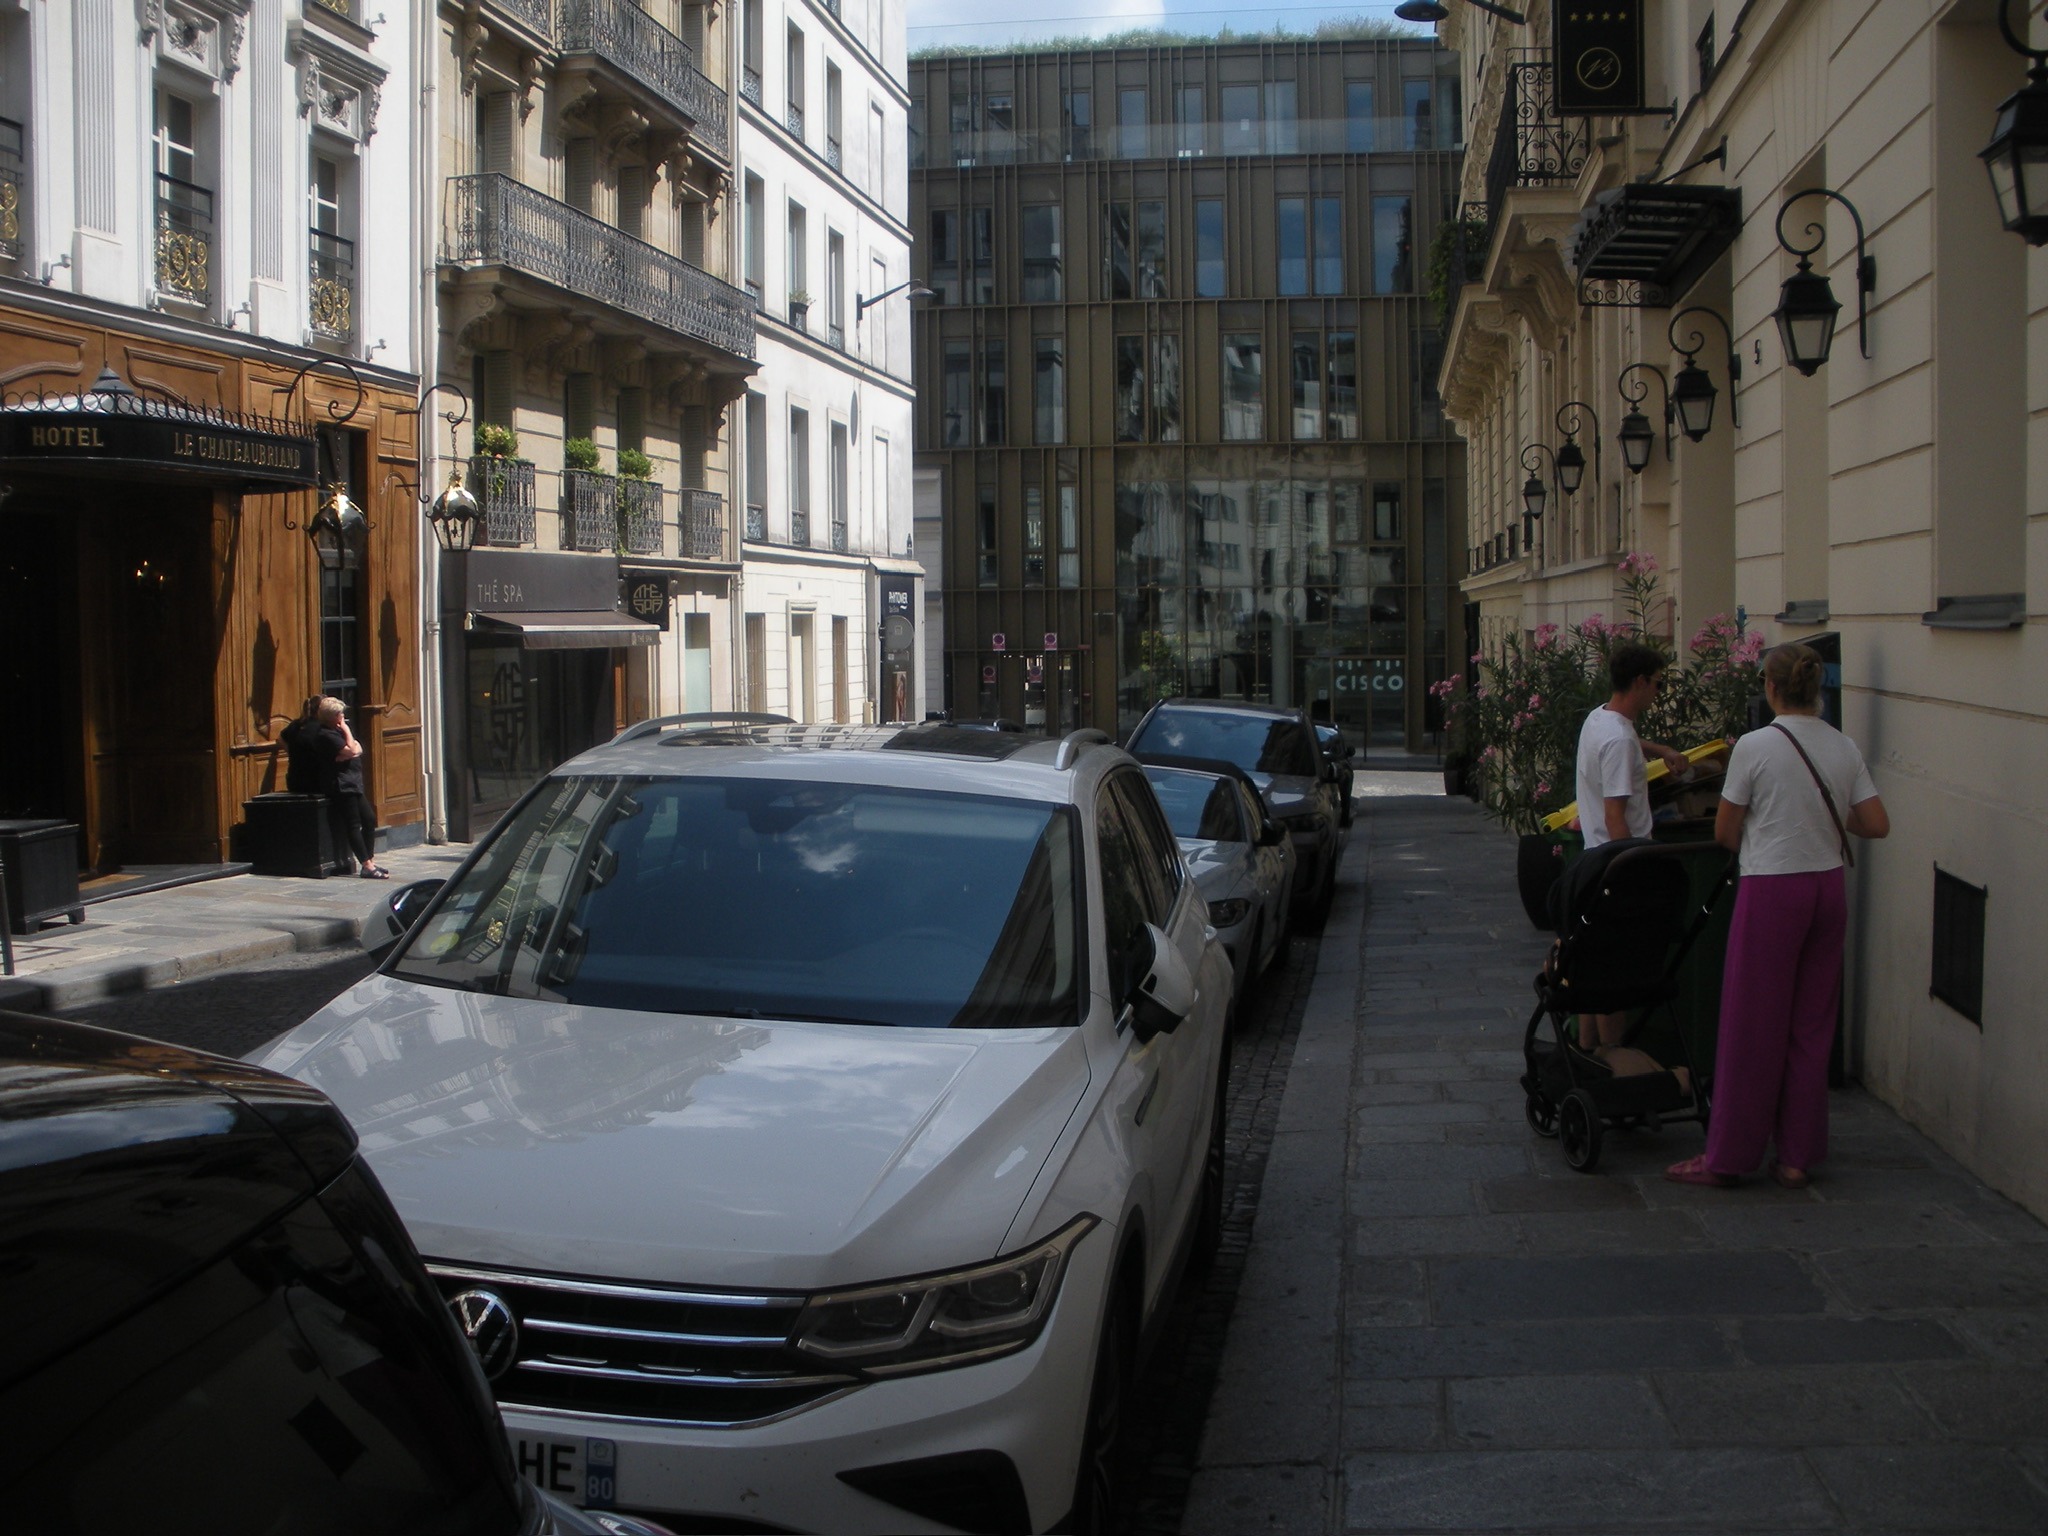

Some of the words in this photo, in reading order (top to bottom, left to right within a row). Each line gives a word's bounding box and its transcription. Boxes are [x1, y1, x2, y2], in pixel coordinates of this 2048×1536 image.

[32, 426, 105, 447] HOTEL
[174, 432, 193, 456] LE
[198, 436, 300, 469] CHATEAUBRIAND
[477, 579, 498, 603] THÉ
[503, 584, 524, 603] SPA
[1335, 675, 1404, 691] CISCO
[518, 1440, 577, 1493] HE
[587, 1475, 613, 1501] 80
